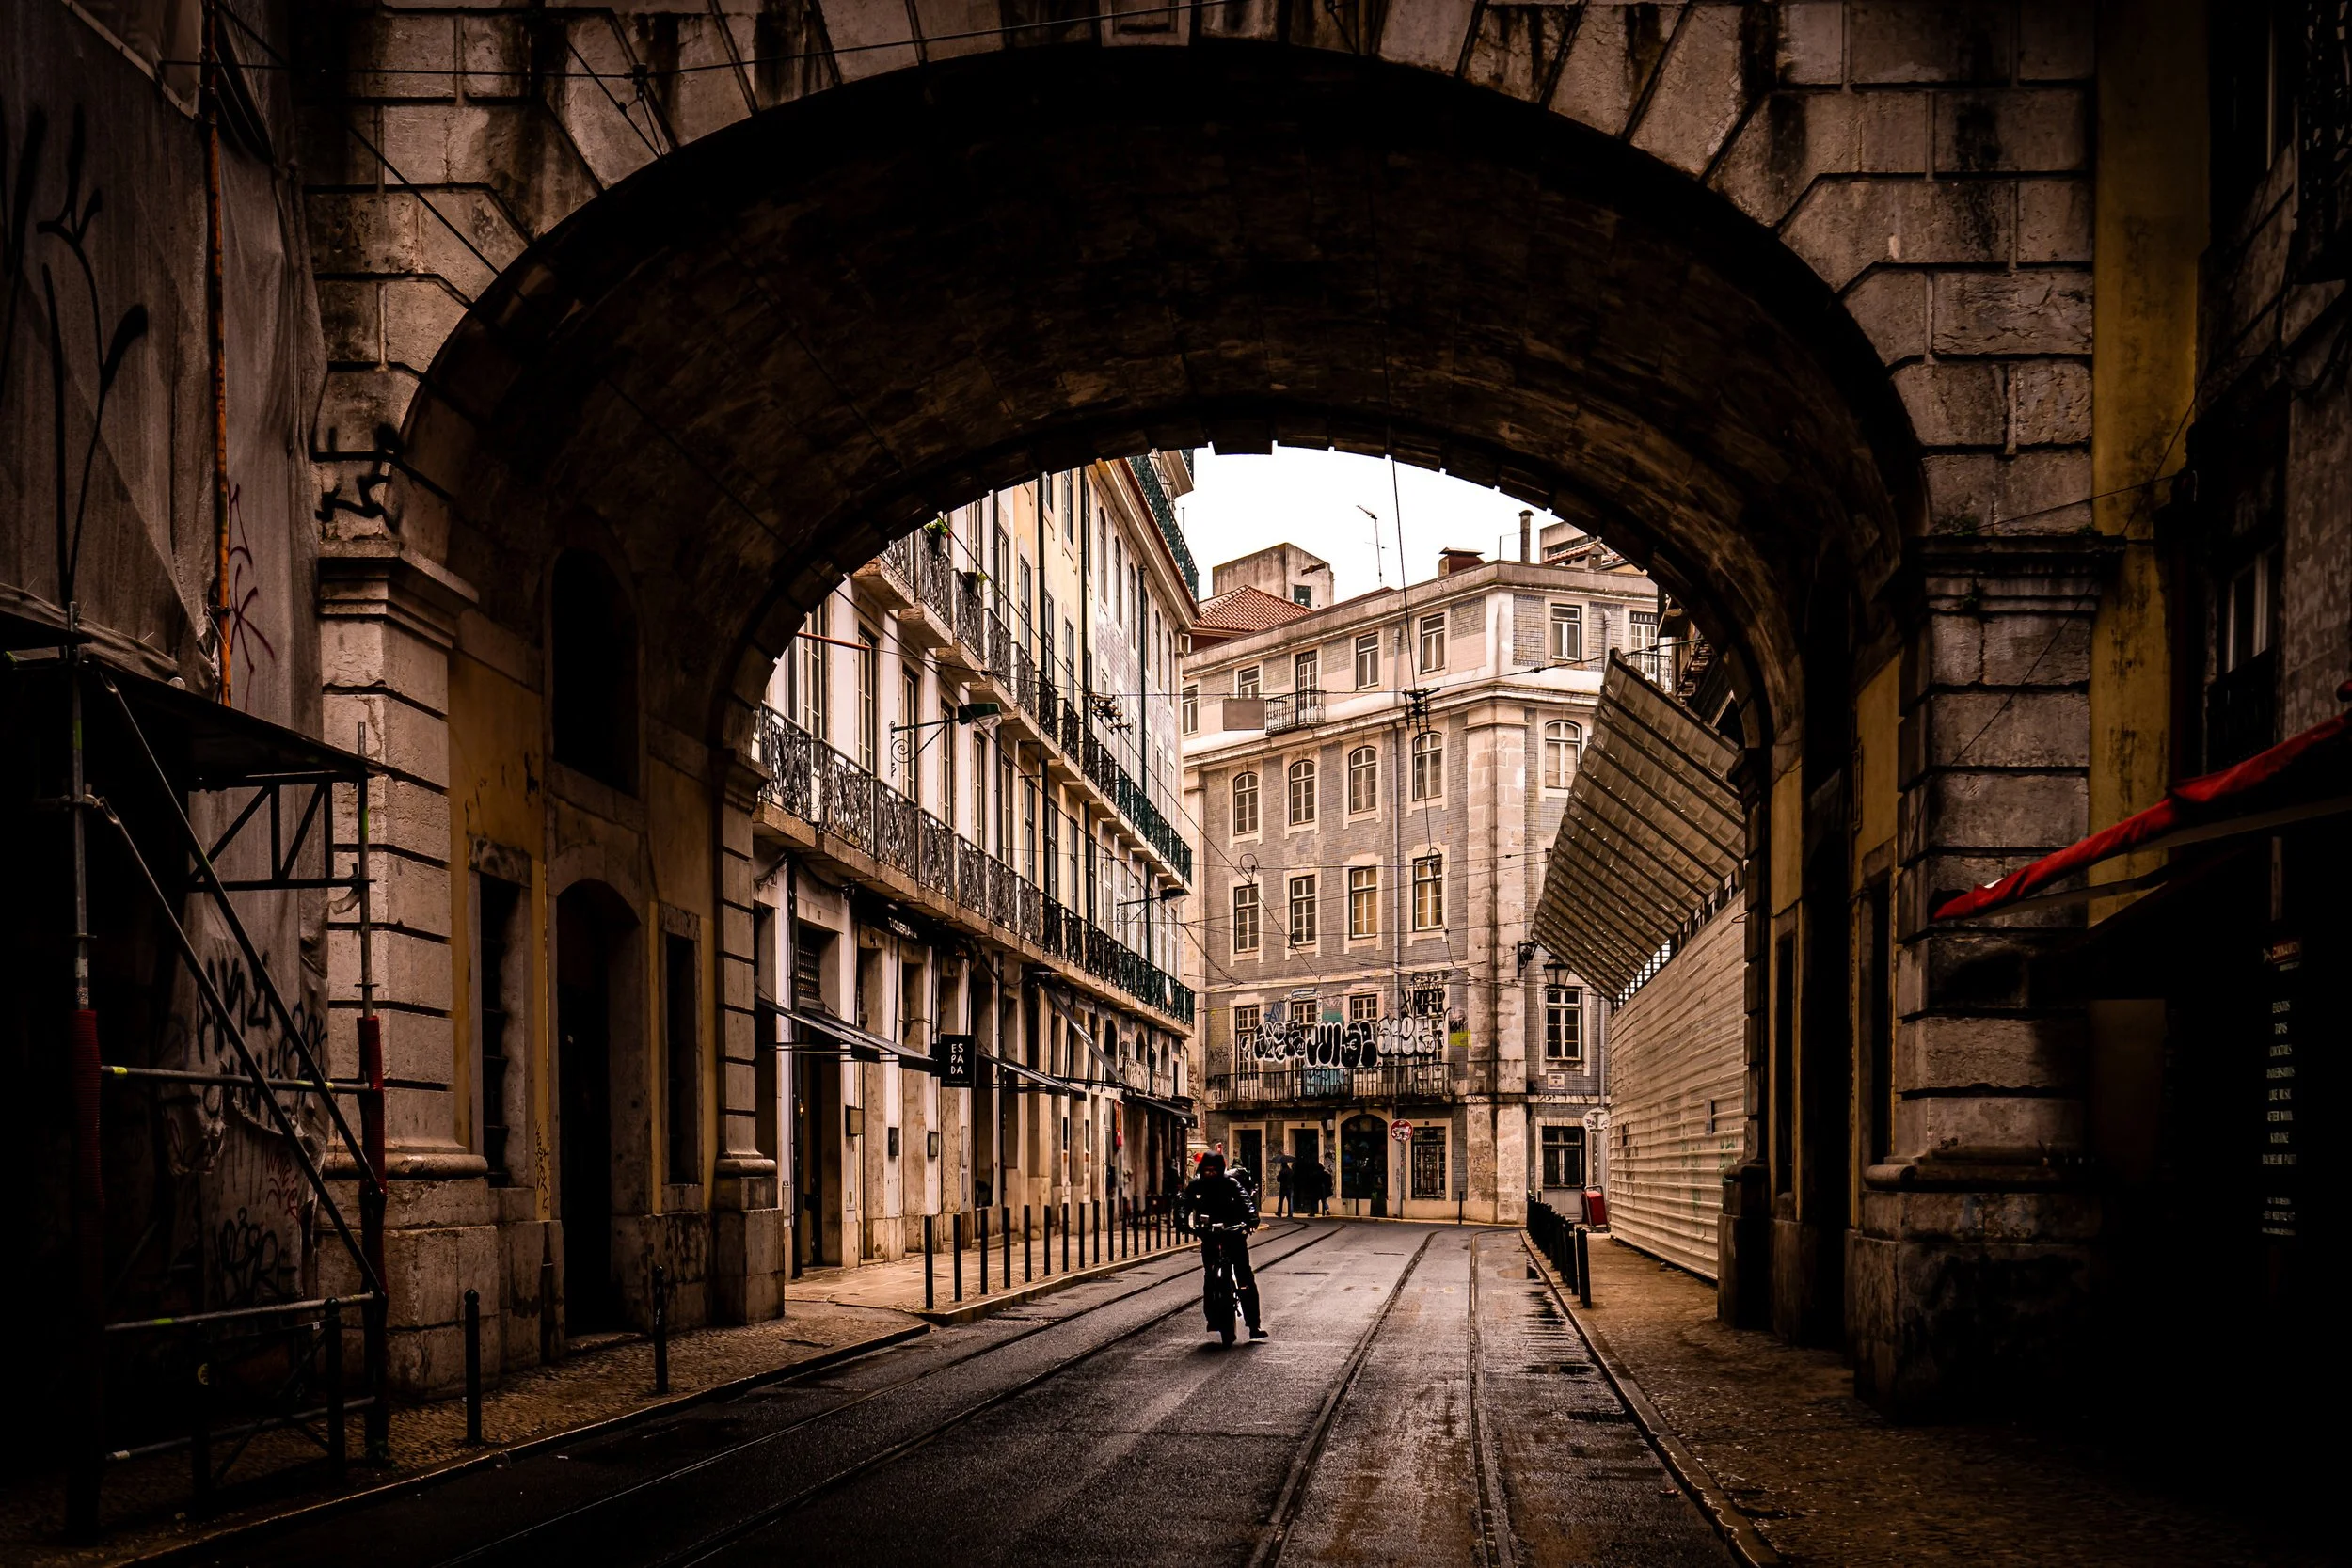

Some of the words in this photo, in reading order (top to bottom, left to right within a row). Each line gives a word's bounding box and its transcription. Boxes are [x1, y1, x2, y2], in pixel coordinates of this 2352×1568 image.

[951, 1043, 964, 1053] ES
[950, 1054, 964, 1064] PA
[950, 1066, 964, 1075] DA
